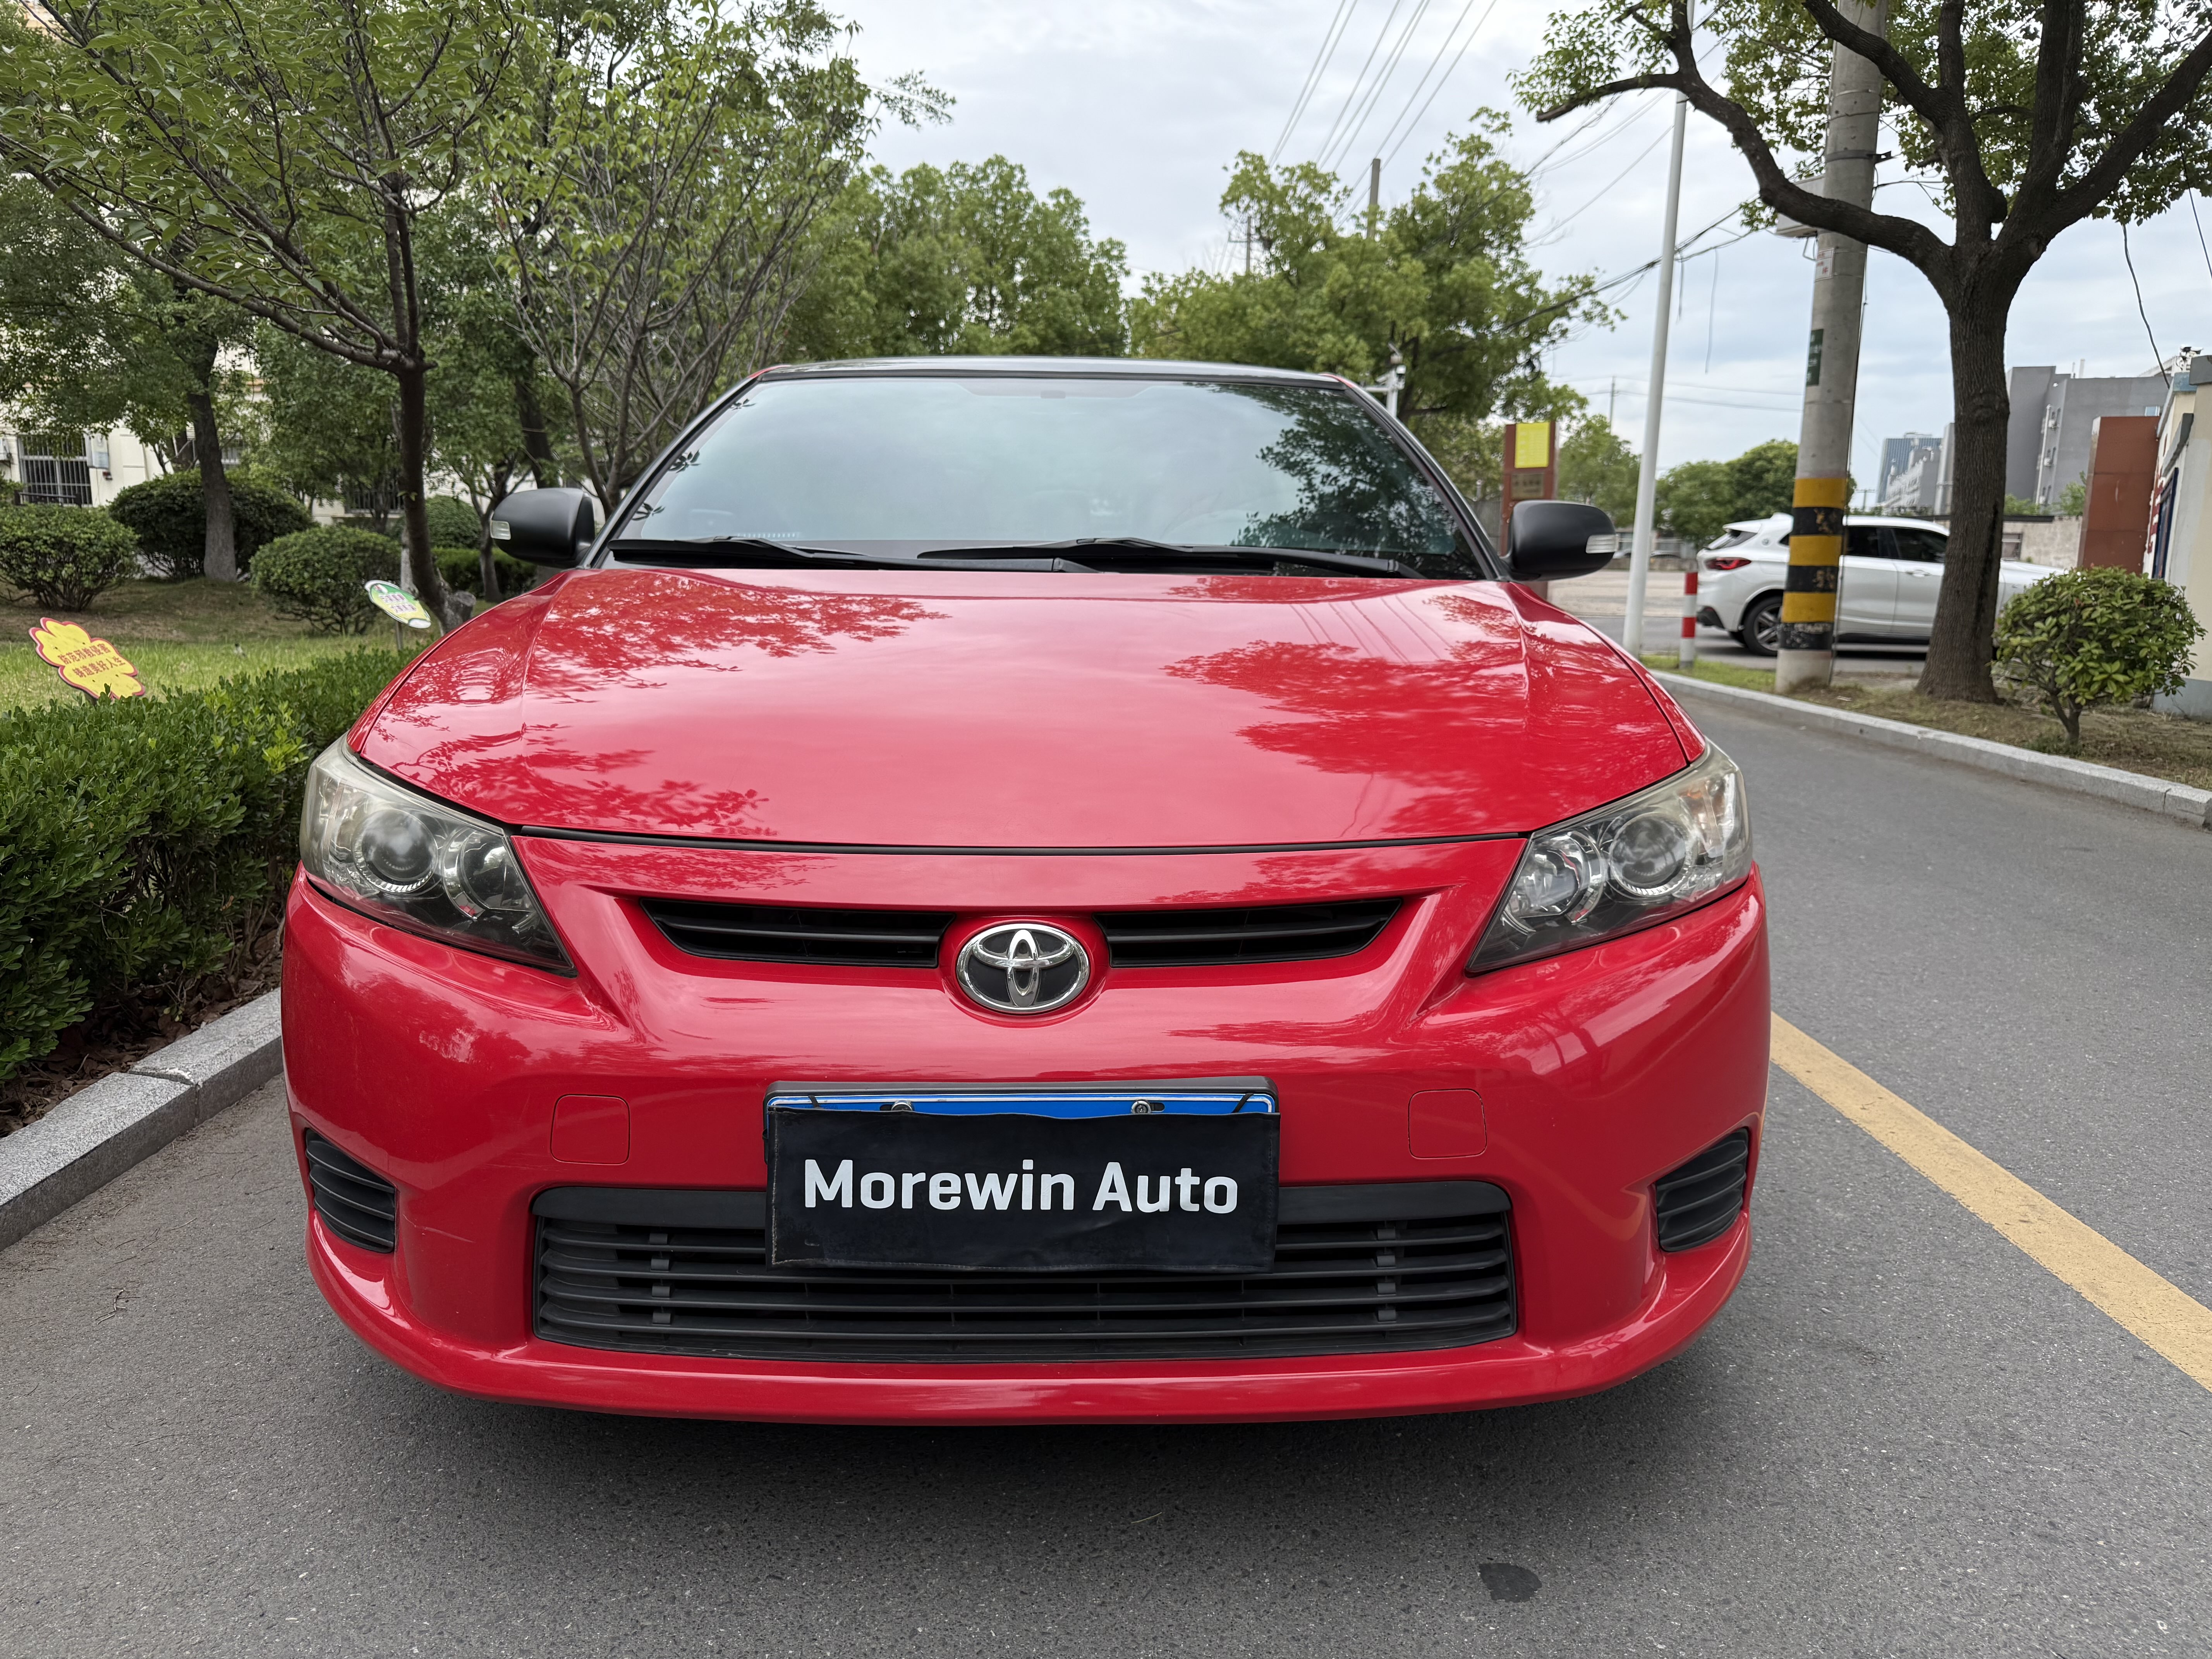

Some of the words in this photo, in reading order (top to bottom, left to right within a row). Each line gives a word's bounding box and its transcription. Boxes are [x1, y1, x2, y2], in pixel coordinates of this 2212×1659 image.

[57, 643, 111, 665] 防范邪教侵害
[805, 1159, 1074, 1210] Morewin
[1092, 1162, 1238, 1214] Auto
